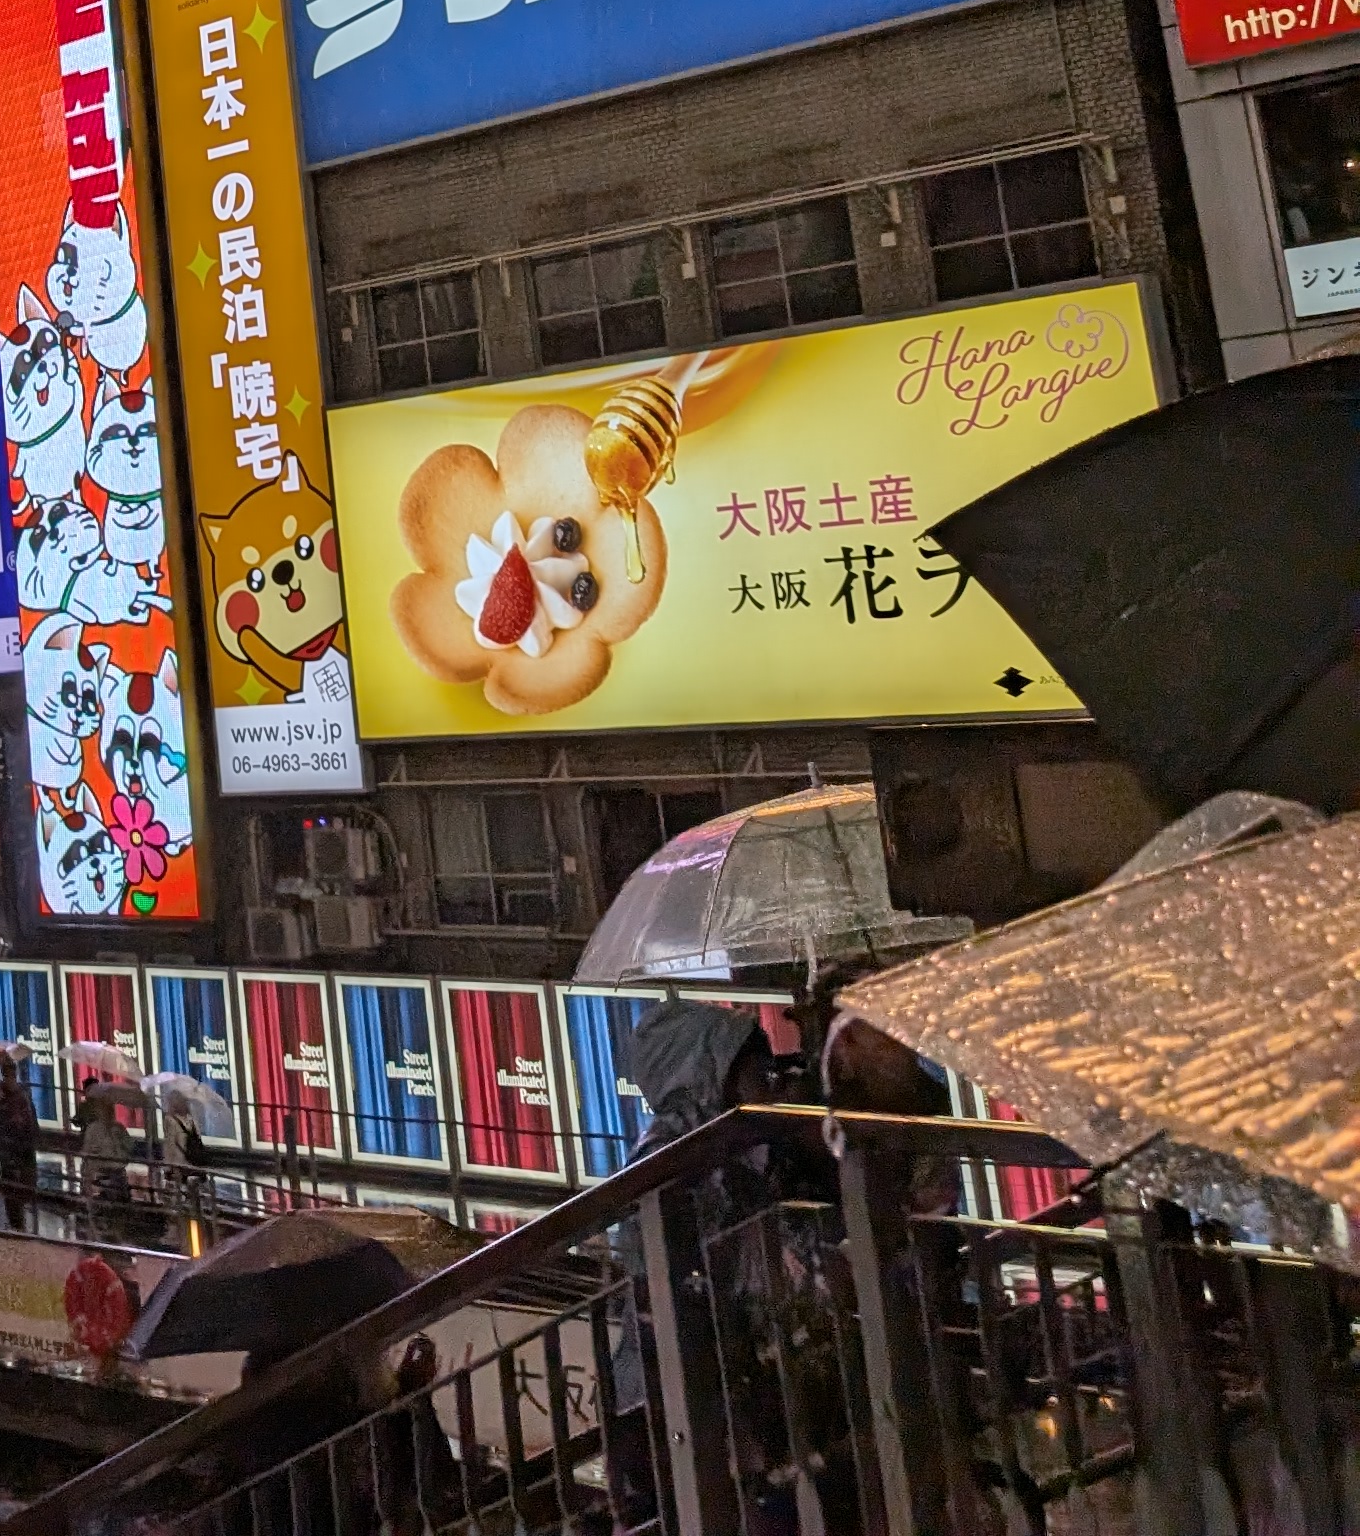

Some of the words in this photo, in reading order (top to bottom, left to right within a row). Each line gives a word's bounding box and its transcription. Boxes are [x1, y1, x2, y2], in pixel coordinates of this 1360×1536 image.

[896, 326, 1035, 405] Hana
[949, 354, 1120, 437] Langue
[716, 474, 918, 540] 大阪土産
[728, 568, 811, 613] 大阪
[230, 718, 343, 746] www.jsv.jp
[231, 751, 349, 775] 06-4963-3661
